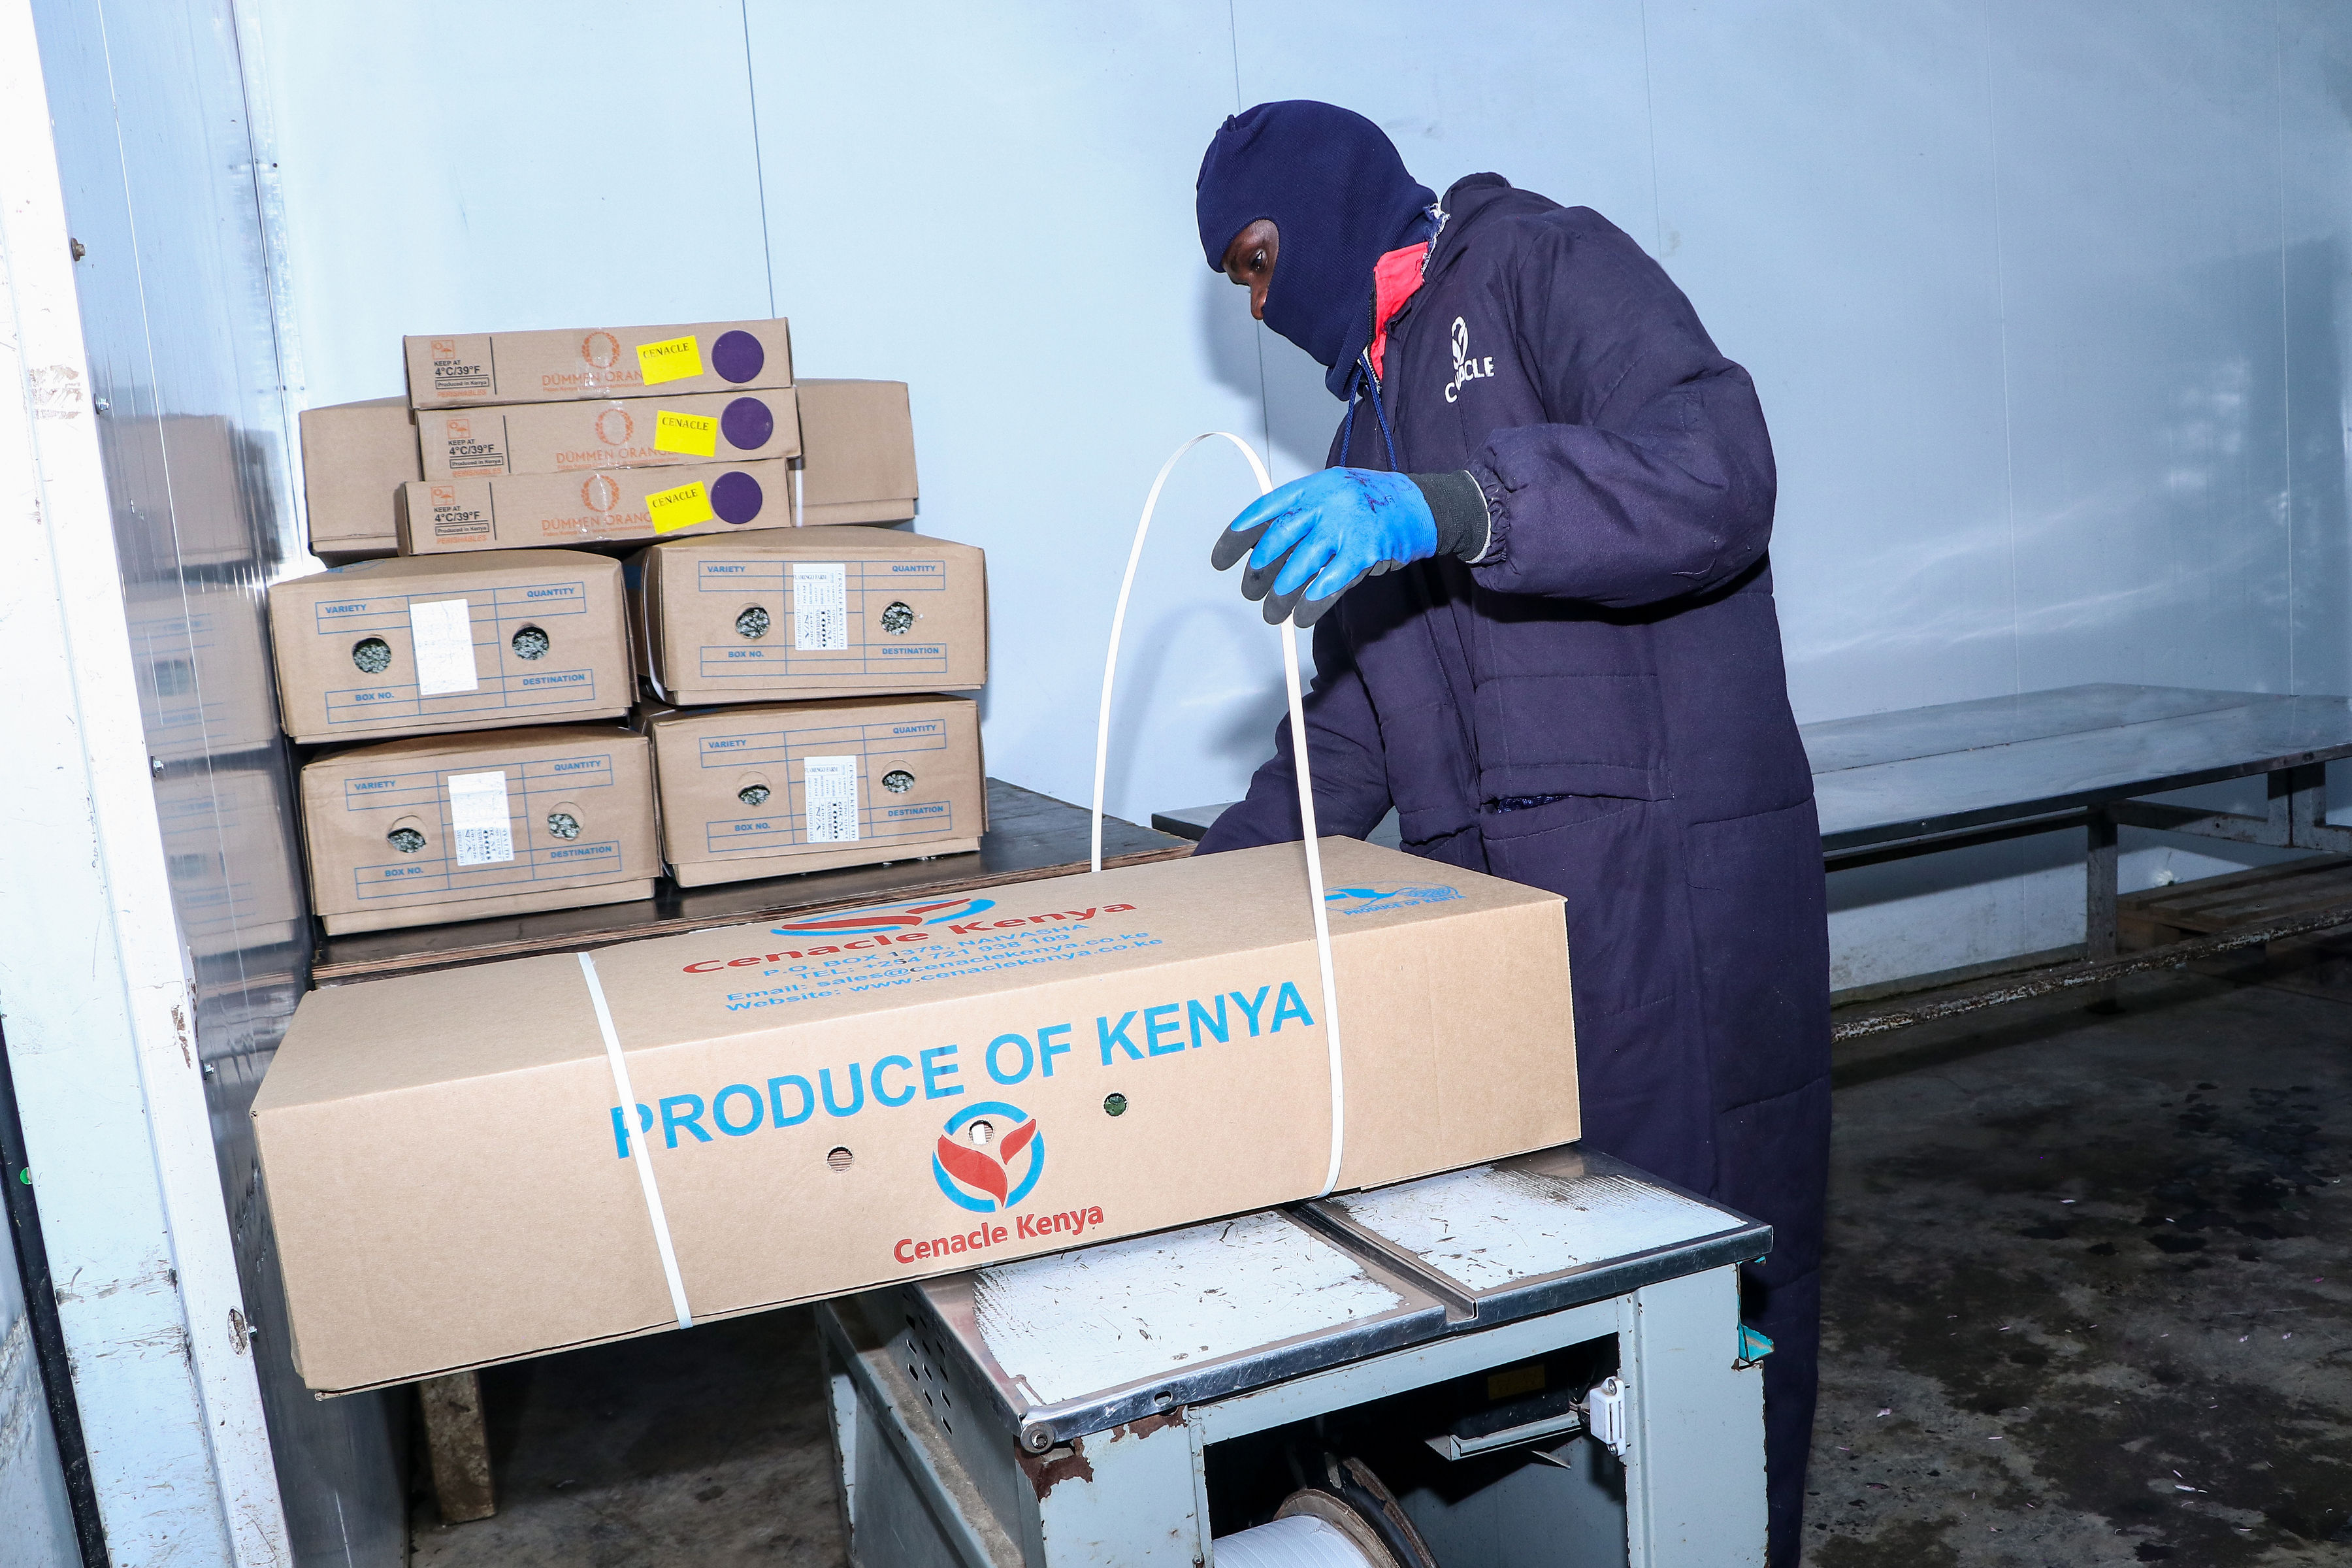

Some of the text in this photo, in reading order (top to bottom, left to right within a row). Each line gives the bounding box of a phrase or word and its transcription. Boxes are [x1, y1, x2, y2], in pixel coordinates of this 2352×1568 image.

[643, 342, 690, 359] CENACLE
[434, 365, 480, 376] 4°C/39°F
[605, 370, 643, 382] ORAN
[662, 417, 709, 431] CENACLE
[449, 444, 495, 455] 4°C/39°F
[652, 488, 698, 508] CENACLE
[434, 511, 480, 522] 4°C/39°F
[527, 587, 575, 598] QUANTITY
[325, 603, 367, 614] VARIETY
[523, 674, 585, 686] DESTINATION
[355, 693, 373, 702] BOX
[892, 725, 936, 734] QUANTITY
[708, 740, 747, 749] VARIETY
[554, 760, 601, 771] QUANTITY
[354, 780, 396, 791] VARIETY
[888, 806, 943, 817] DESTINATION
[550, 845, 612, 858] DESTINATION
[1344, 903, 1402, 915] PRODUCE
[683, 904, 1137, 973] Cenacle Kenya
[763, 924, 1090, 977] P.O. BOX 1378, NAIVASHA
[794, 934, 1070, 981] TEL: +254 721 938 109
[726, 932, 1150, 1001] Email: sales@cenaclekenya.co.ke
[725, 939, 1163, 1011] Website: www.cenaclekenya.co.ke
[610, 981, 1315, 1159] PRODUCE OF KENYA
[893, 1205, 1105, 1264] Cenacle Kenya
